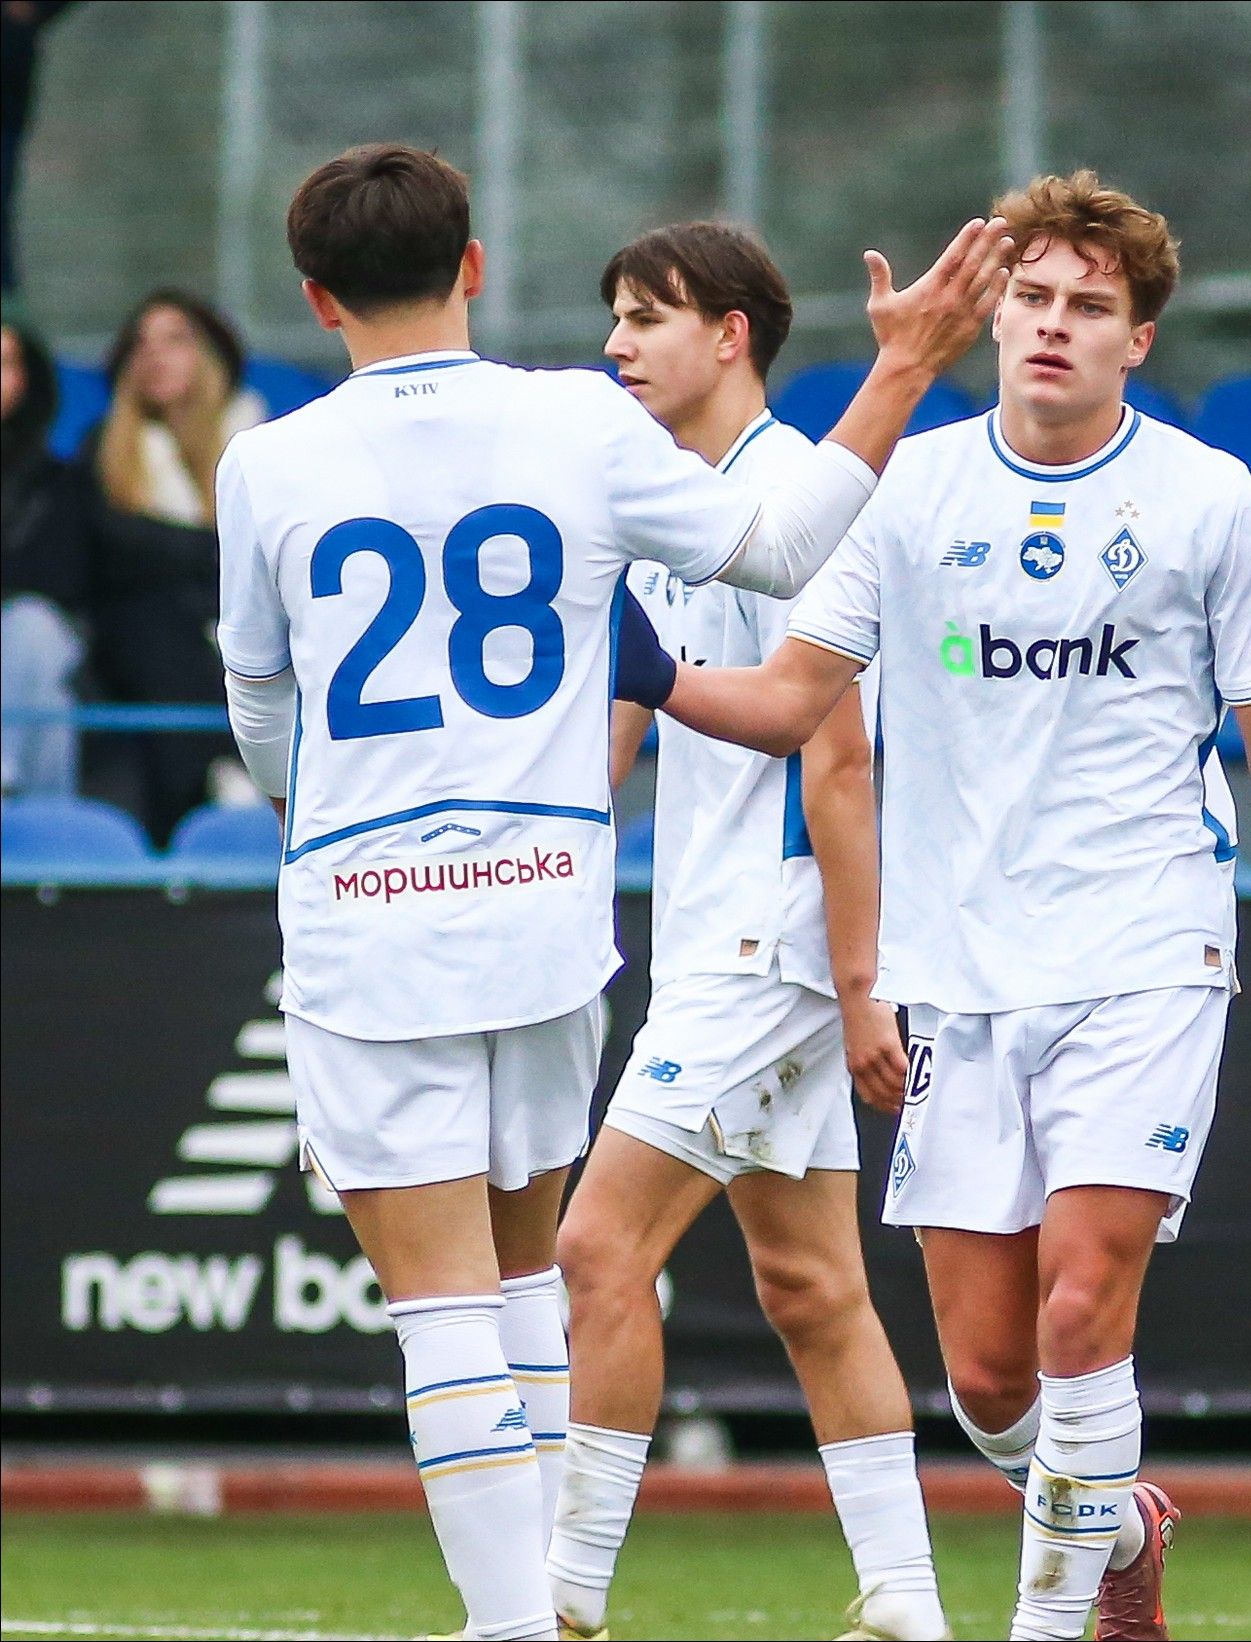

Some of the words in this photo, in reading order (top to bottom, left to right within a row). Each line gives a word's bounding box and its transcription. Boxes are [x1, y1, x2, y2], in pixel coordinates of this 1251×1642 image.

[394, 382, 439, 398] KYIV
[310, 502, 566, 741] 28
[333, 846, 574, 904] моршинська
[60, 1251, 263, 1334] new
[1036, 1494, 1118, 1517] FCDK
